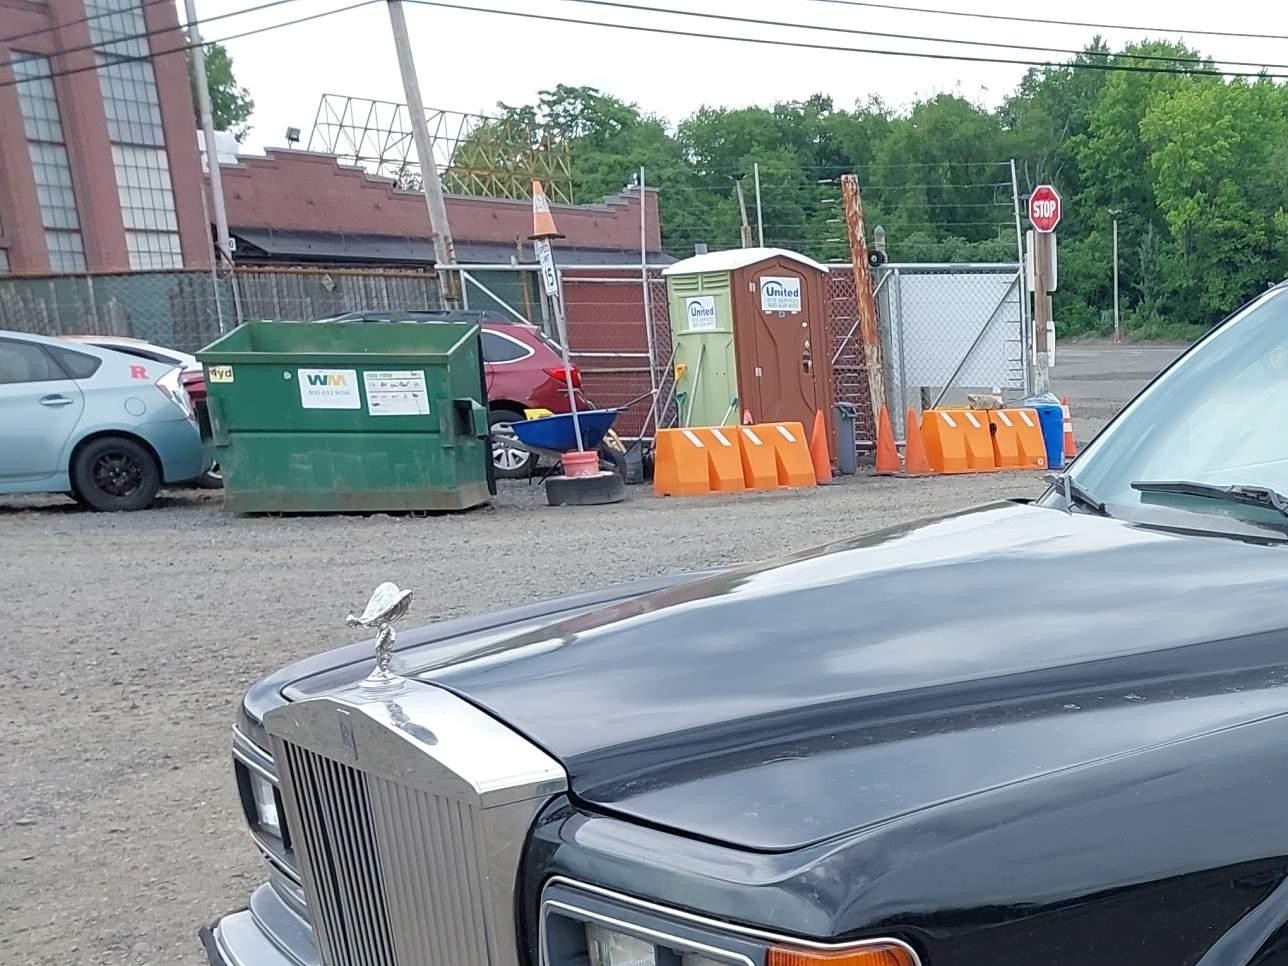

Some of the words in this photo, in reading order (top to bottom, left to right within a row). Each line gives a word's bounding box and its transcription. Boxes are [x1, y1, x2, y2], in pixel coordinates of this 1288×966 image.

[1033, 200, 1056, 218] STOP
[544, 268, 555, 287] 15
[766, 286, 799, 297] United
[690, 305, 714, 316] United
[129, 365, 150, 379] R
[306, 374, 346, 386] WM
